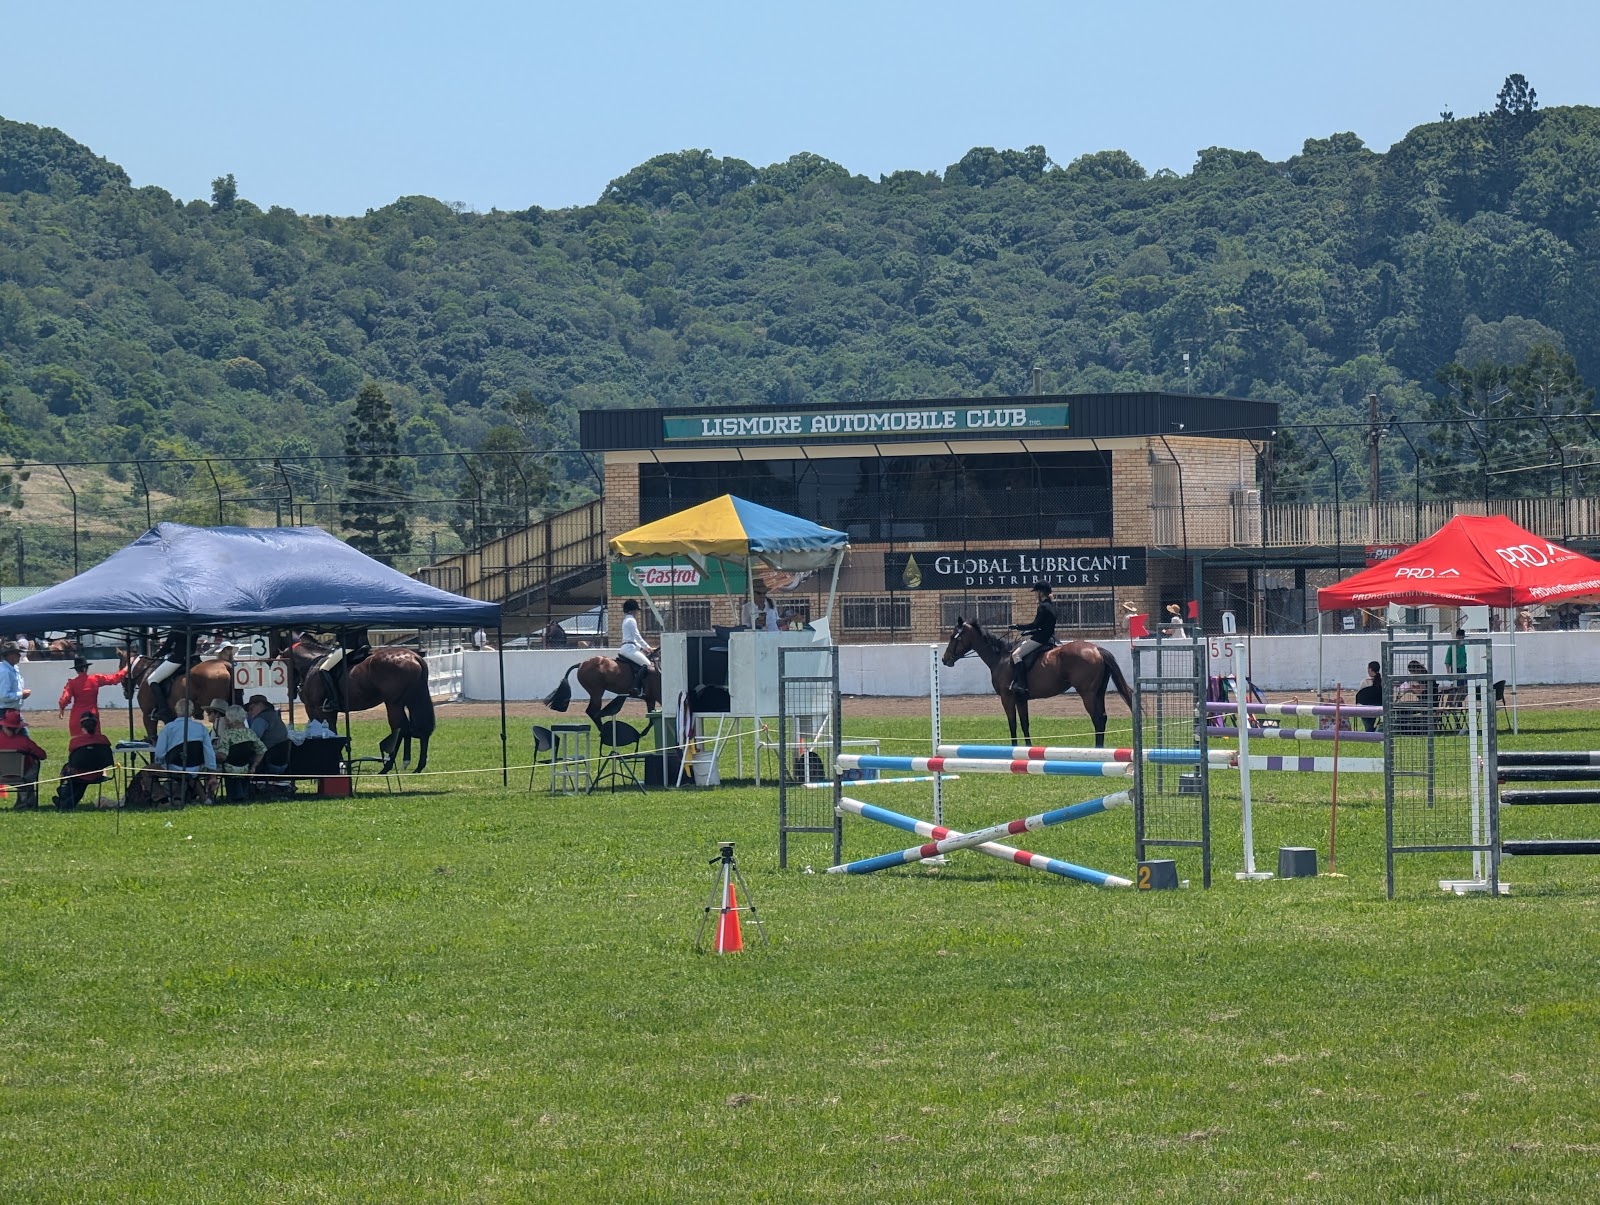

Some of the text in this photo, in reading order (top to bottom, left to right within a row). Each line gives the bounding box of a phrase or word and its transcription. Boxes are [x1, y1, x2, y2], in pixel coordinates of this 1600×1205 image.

[701, 415, 803, 436] LISMORE
[810, 410, 957, 433] AUTOMOBILE
[966, 408, 1027, 428] CLUB
[934, 554, 1131, 575] GLOBAL LUBRICANT
[645, 568, 697, 584] Castrol
[965, 573, 1101, 586] DISTRIBUTORS
[1225, 616, 1231, 632] 1
[253, 638, 267, 656] 3
[1138, 866, 1151, 888] 2
